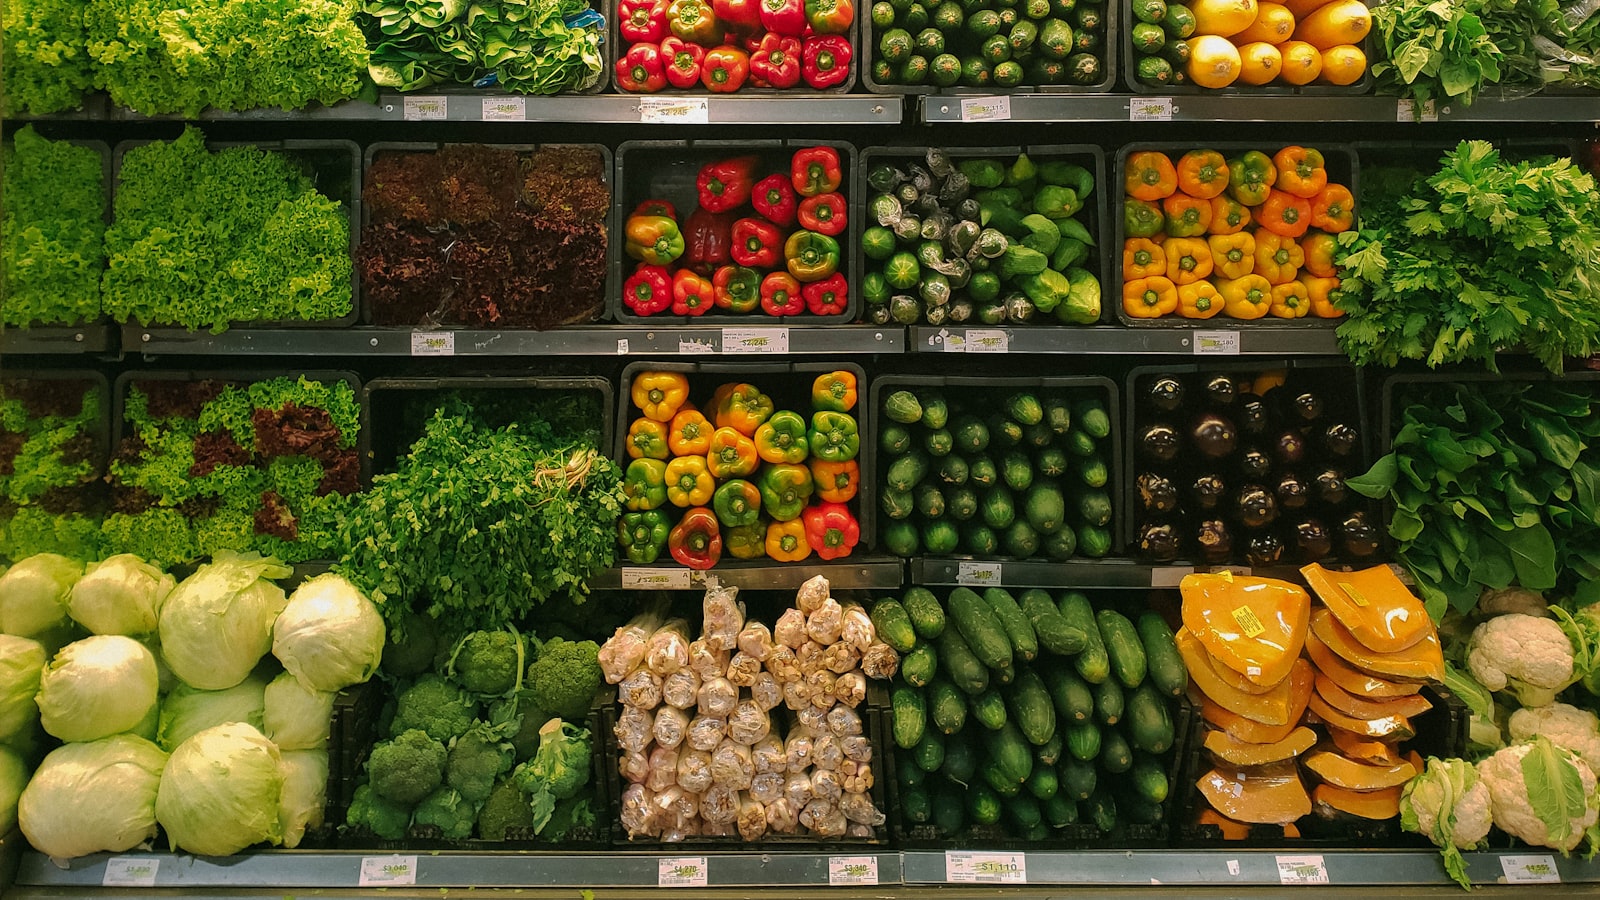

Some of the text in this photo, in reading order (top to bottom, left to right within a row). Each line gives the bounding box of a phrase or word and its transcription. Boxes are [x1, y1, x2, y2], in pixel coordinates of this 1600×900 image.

[701, 102, 707, 110] A
[781, 332, 787, 340] A
[741, 339, 769, 347] $2,245
[870, 856, 876, 865] A
[674, 865, 698, 874] $4,270
[844, 864, 868, 873] $3,340
[981, 863, 1018, 873] $1,110
